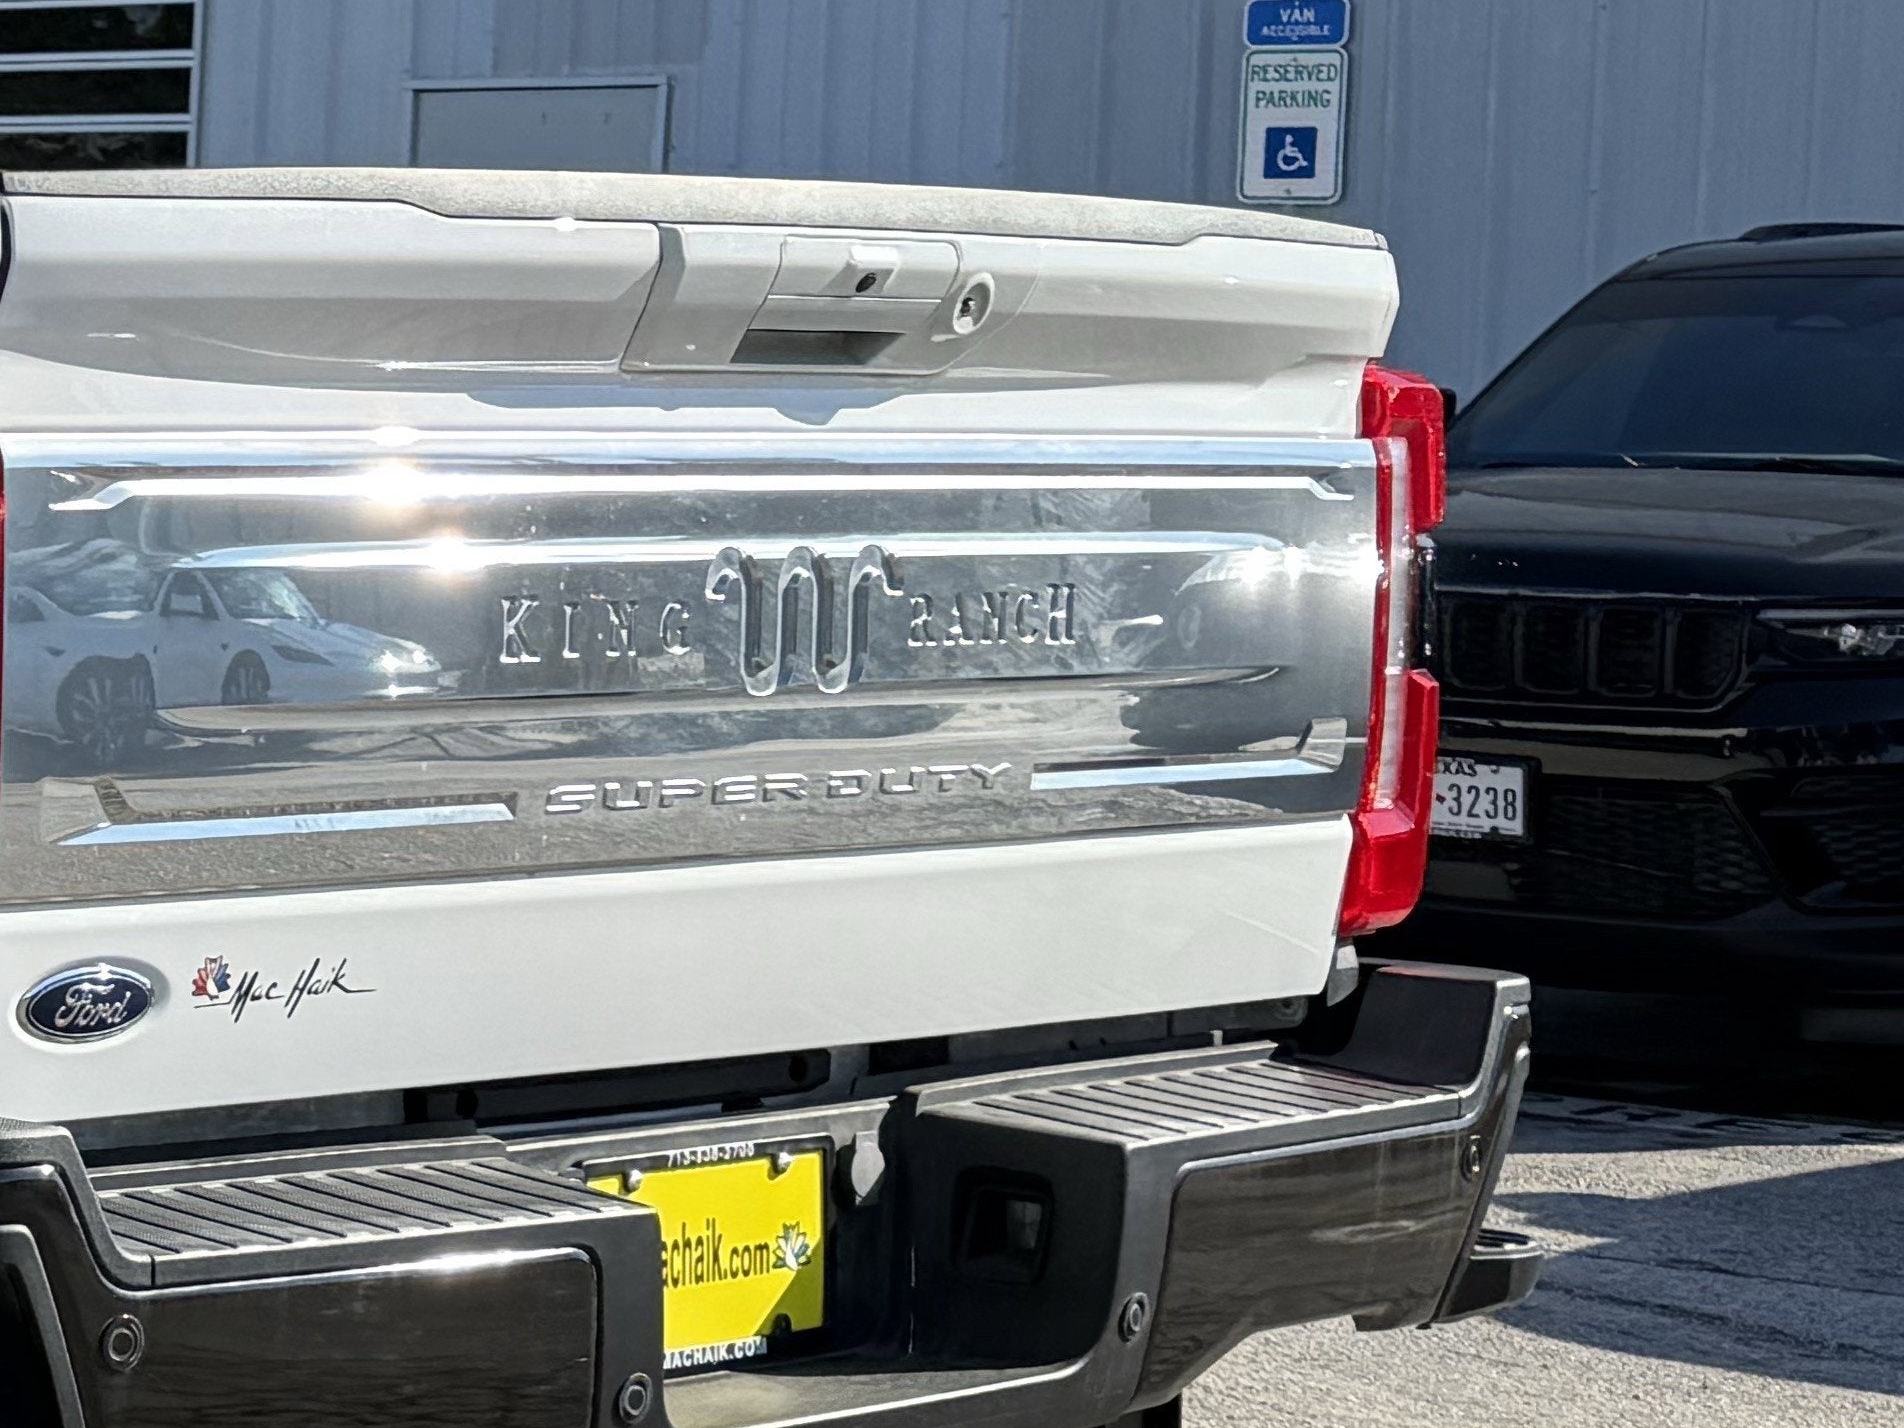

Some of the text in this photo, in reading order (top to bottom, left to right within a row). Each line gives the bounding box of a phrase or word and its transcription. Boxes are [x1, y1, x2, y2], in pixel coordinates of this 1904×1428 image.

[1261, 24, 1331, 38] ACCESSIBLE
[1279, 7, 1316, 23] VAN
[1249, 62, 1339, 83] RESERVED
[1254, 89, 1332, 109] PARKING
[499, 581, 1077, 663] KING RANCH
[545, 760, 1013, 815] SUPER DUTY
[1447, 782, 1518, 822] 3238
[53, 979, 129, 1028] Ford
[193, 956, 378, 1024] Mac Haik
[660, 1217, 771, 1290] achaik.com
